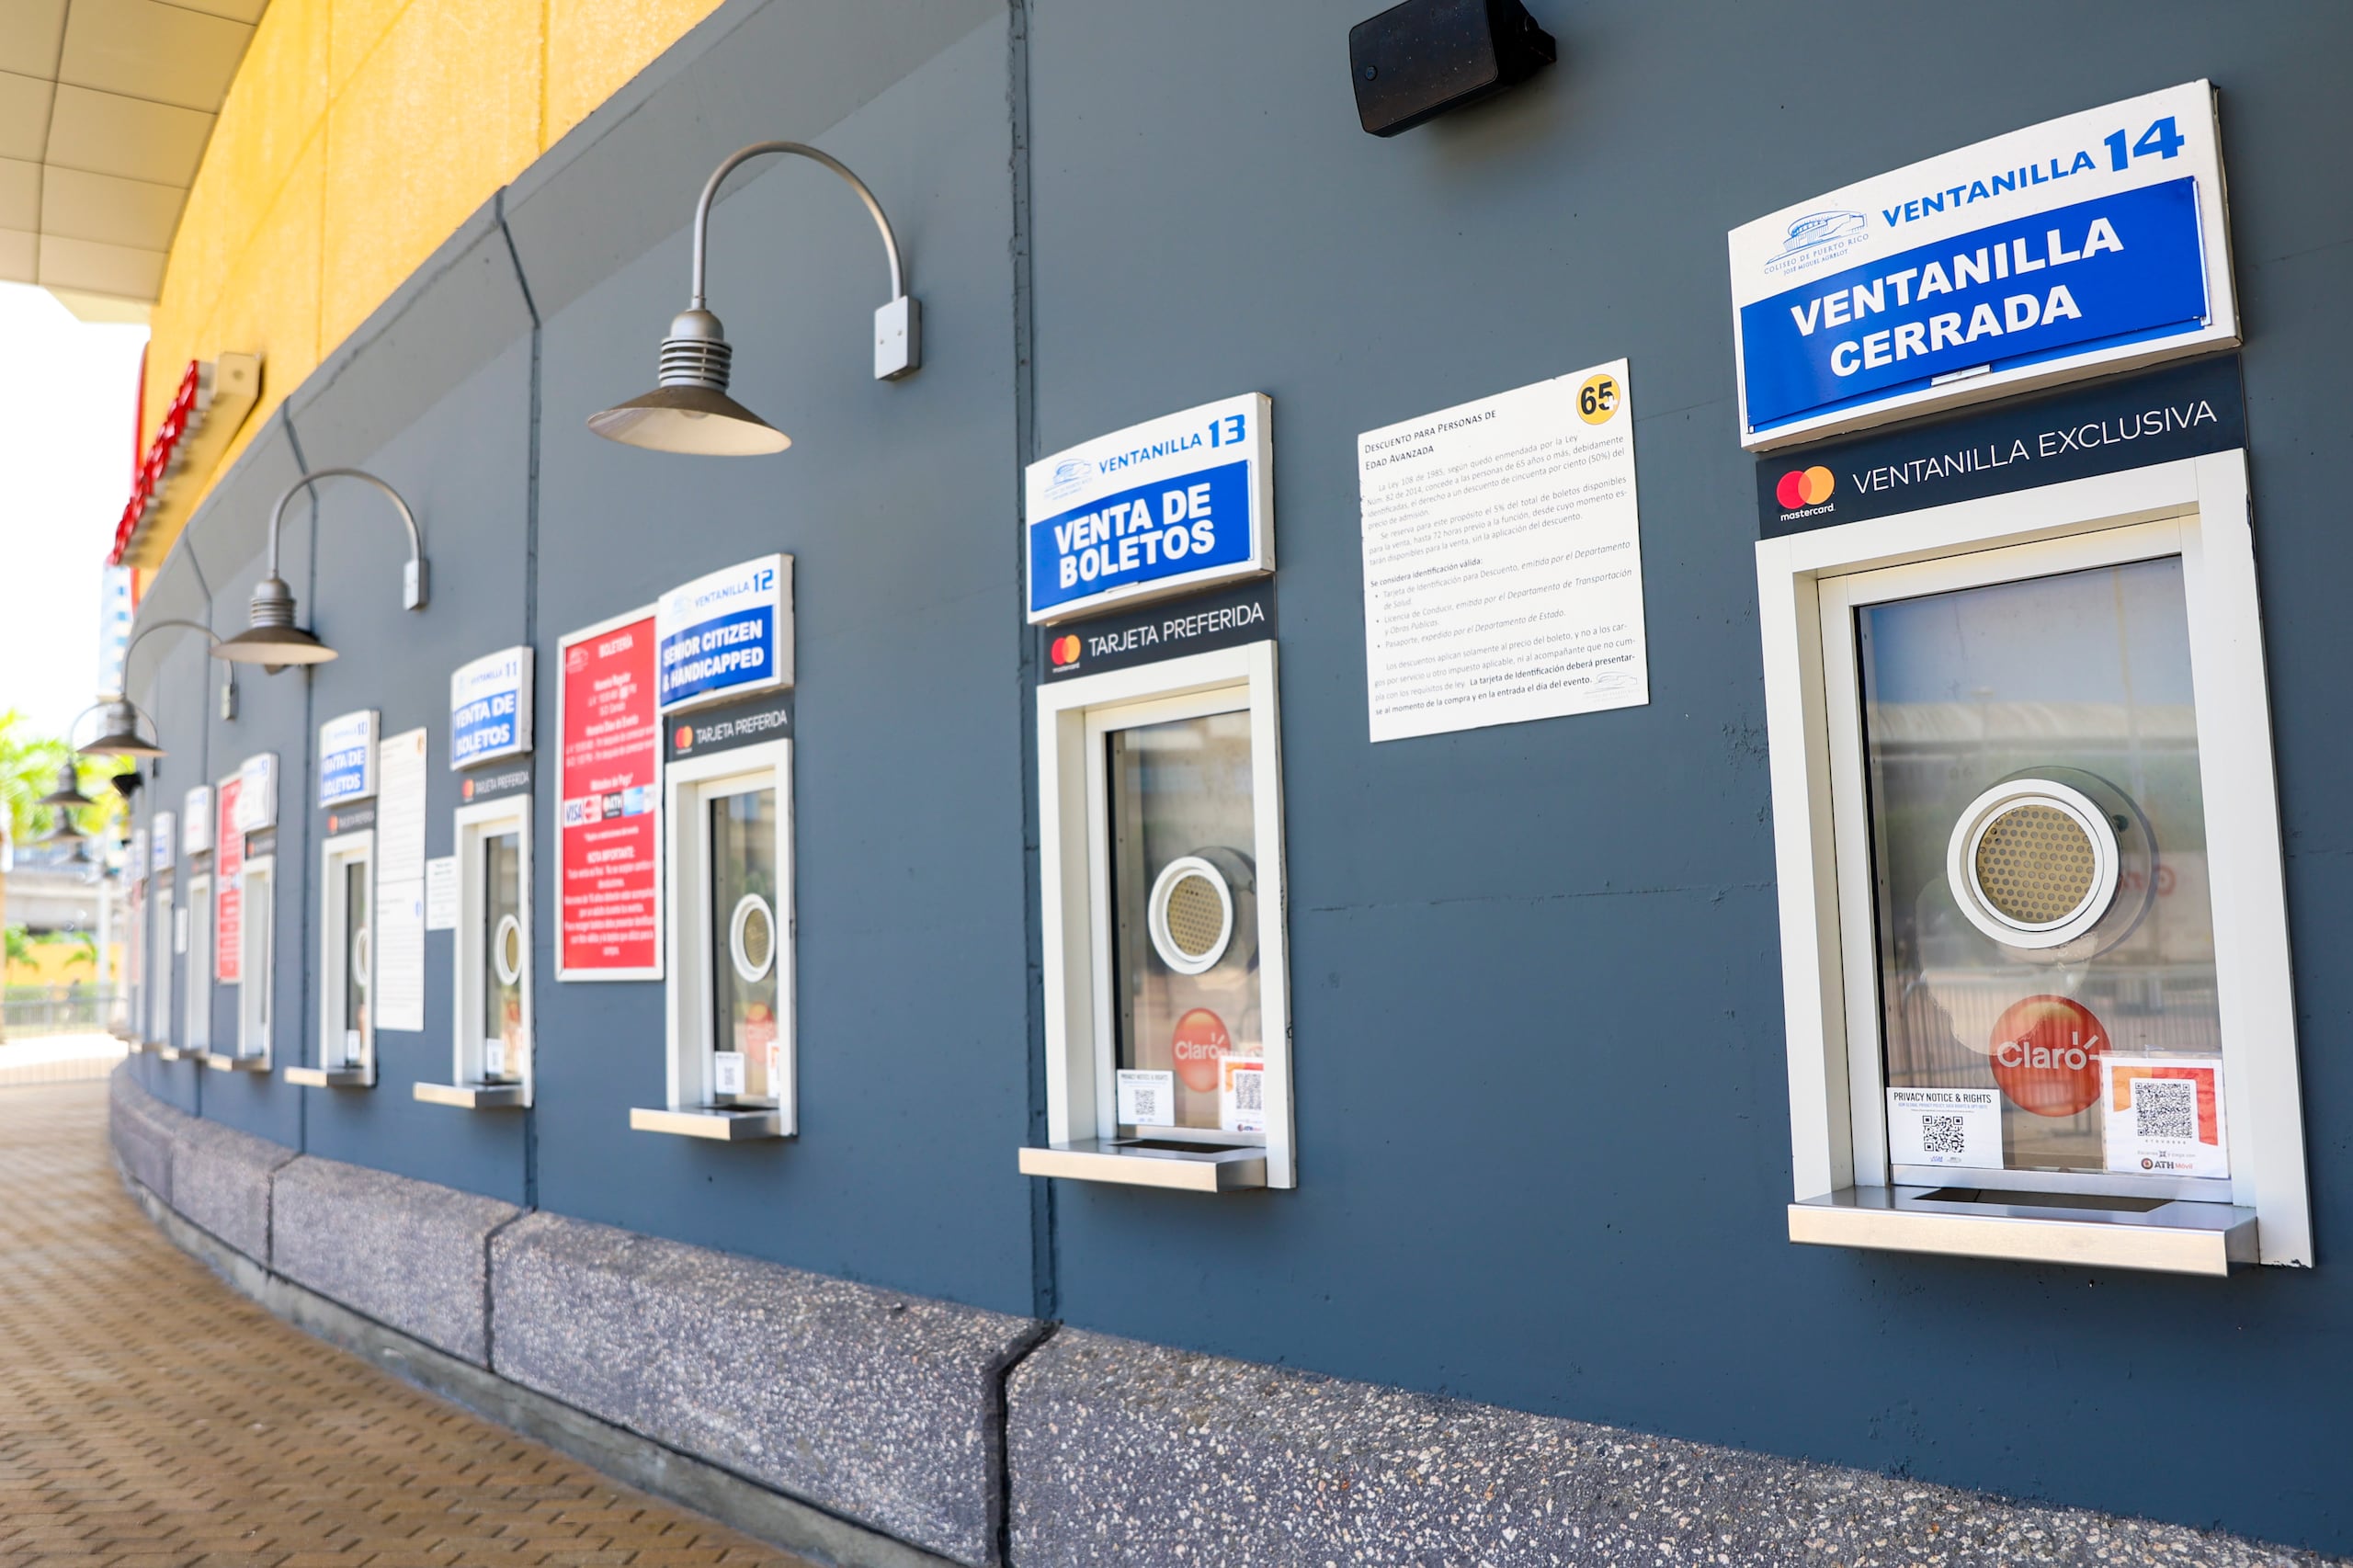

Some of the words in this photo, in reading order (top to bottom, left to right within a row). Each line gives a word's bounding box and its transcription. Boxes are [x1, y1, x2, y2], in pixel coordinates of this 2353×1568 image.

[1881, 150, 2096, 228] VENTANILLA
[2104, 116, 2185, 172] 14
[1764, 258, 1797, 274] COLISEO
[1800, 253, 1810, 262] DE
[1813, 242, 1845, 257] PUERTO
[1848, 233, 1870, 245] RICO
[1790, 217, 2124, 338] VENTANILLA
[1830, 285, 2082, 378] CERRADA
[1098, 433, 1202, 474] VENTANILLA
[1208, 414, 1245, 449] 13
[1472, 465, 1503, 481] personas
[1573, 436, 1623, 454] debidamente
[1495, 443, 1537, 460] enmendada
[1540, 439, 1552, 450] por
[1565, 433, 1577, 442] Ley
[1852, 439, 2029, 494] VENTANILLA
[2038, 400, 2217, 456] EXCLUSIVA
[1511, 467, 1546, 482] cincuenta
[1548, 463, 1562, 474] por
[1563, 458, 1586, 469] ciento
[1588, 449, 1609, 464] (50%)
[1612, 447, 1624, 457] del
[1506, 499, 1518, 509] del
[1520, 494, 1537, 506] total
[1552, 486, 1580, 499] boletos
[1583, 475, 1626, 492] disponibles
[1532, 505, 1554, 516] desde
[1556, 501, 1574, 511] cuyo
[1575, 492, 1613, 506] momento
[1054, 498, 1153, 555] VENTA
[1162, 483, 1211, 525] DE
[1528, 520, 1540, 530] del
[1541, 512, 1582, 527] descuento.
[1779, 503, 1836, 522] mastercard
[1060, 519, 1215, 589] BOLETOS
[1462, 572, 1478, 583] para
[1521, 557, 1549, 569] emitida
[1551, 554, 1563, 565] por
[1574, 540, 1631, 558] Departamento
[695, 581, 750, 608] VENTANILLA
[754, 568, 774, 593] 12
[1483, 595, 1495, 606] por
[1507, 583, 1560, 599] Departamento
[1575, 568, 1631, 585] Transportación
[1088, 623, 1159, 657] TARJETA
[1163, 602, 1265, 642] PREFERIDA
[1474, 616, 1526, 631] Departamento
[1539, 608, 1566, 619] Estado.
[663, 635, 700, 667] SENIOR
[702, 619, 763, 651] CITIZEN
[1462, 644, 1499, 656] solamente
[1508, 639, 1531, 651] precio
[1532, 635, 1544, 644] del
[1546, 631, 1573, 642] boleto,
[1599, 625, 1610, 633] los
[1612, 623, 1628, 631] car-
[1534, 645, 1584, 659] acompañante
[1586, 642, 1601, 653] que
[1615, 638, 1635, 646] cum-
[506, 661, 517, 677] 11
[670, 647, 764, 689] HANDICAPPED
[1479, 673, 1502, 684] tarjeta
[1515, 663, 1563, 677] Identificación
[1566, 658, 1592, 669] deberá
[1595, 653, 1635, 666] presentar-
[491, 693, 515, 717] DE
[1392, 700, 1424, 711] momento
[1444, 694, 1470, 704] compra
[1496, 685, 1524, 696] entrada
[1535, 682, 1547, 690] día
[1549, 679, 1561, 688] del
[1563, 676, 1592, 687] evento.
[456, 722, 510, 756] BOLETOS
[696, 722, 734, 744] TARJETA
[735, 710, 788, 736] PREFERIDA
[566, 803, 583, 822] VISA
[1996, 1039, 2087, 1070] Claro
[1893, 1092, 1925, 1102] PRIVACY
[1926, 1093, 1953, 1102] NOTICE
[1955, 1094, 1961, 1102] &
[1963, 1094, 1992, 1104] RIGHTS
[2154, 1160, 2175, 1169] ATH
